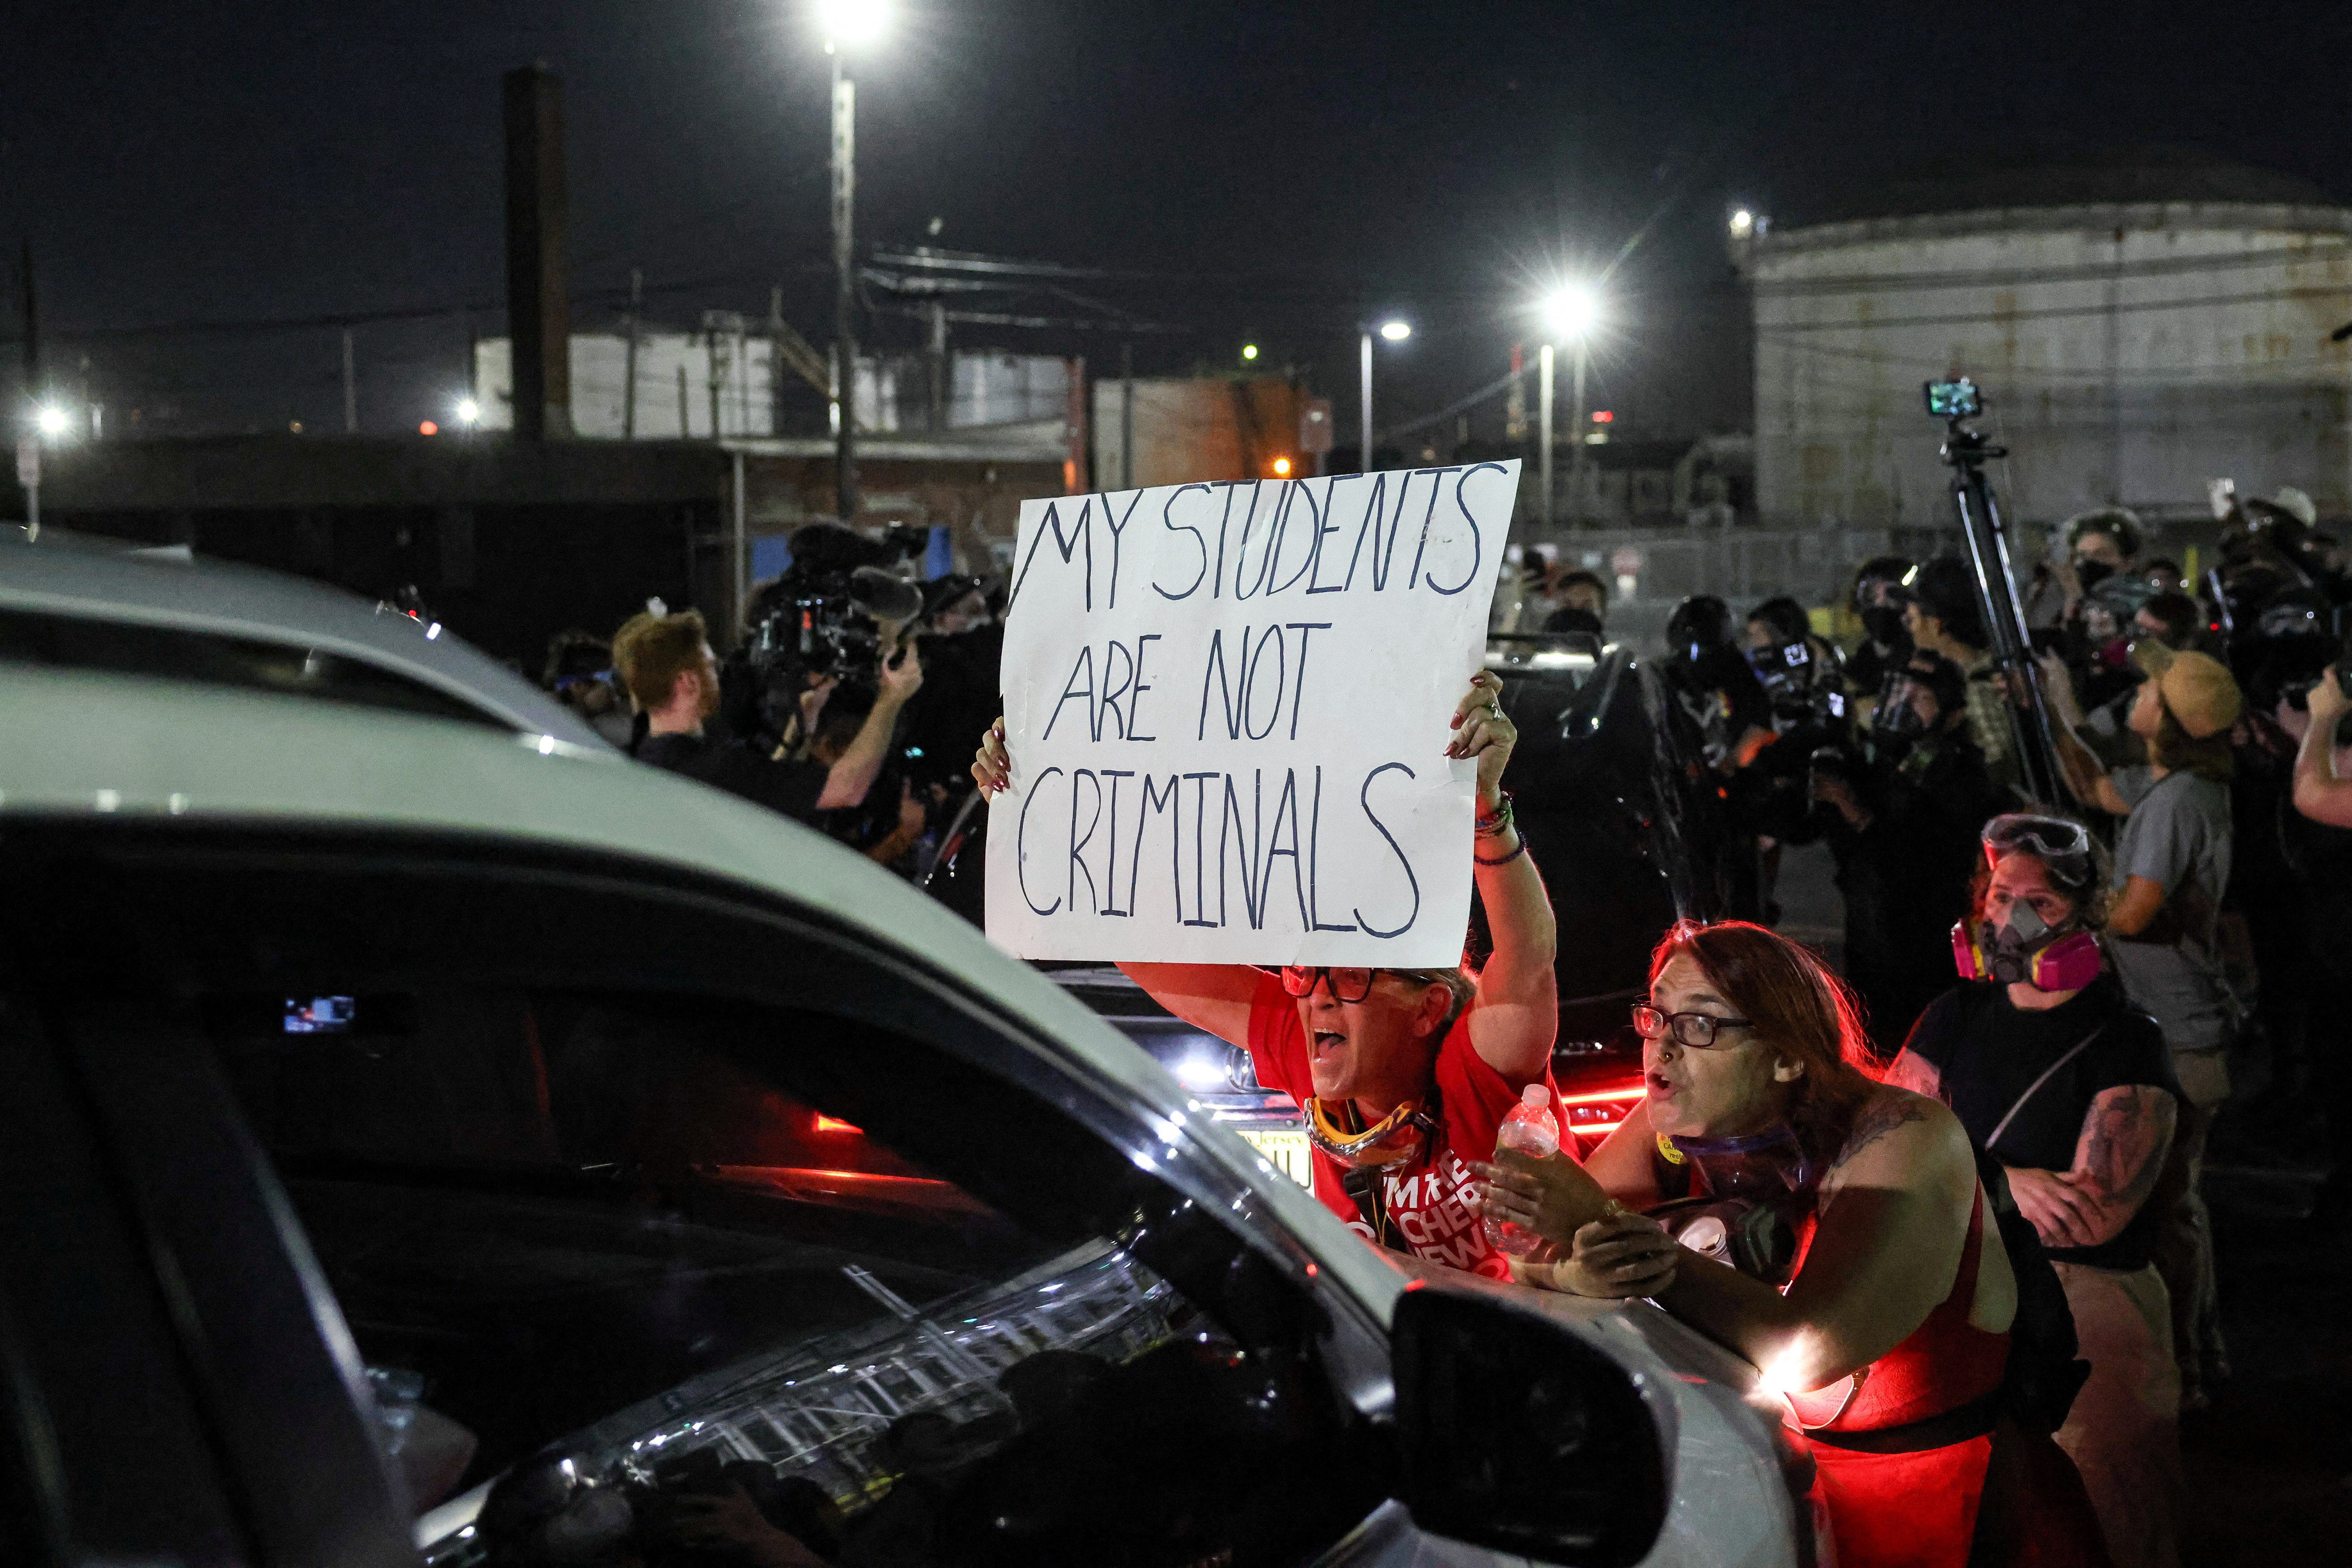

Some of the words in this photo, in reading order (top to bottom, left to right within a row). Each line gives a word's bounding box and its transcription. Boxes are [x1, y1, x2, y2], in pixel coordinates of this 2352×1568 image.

[1007, 488, 1144, 616] MY
[1152, 462, 1509, 601] STUDENTS
[1043, 634, 1162, 743] ARE
[1198, 623, 1332, 741] NOT
[1017, 762, 1420, 939] CRIMINALS
[1398, 1182, 1481, 1244] CHER
